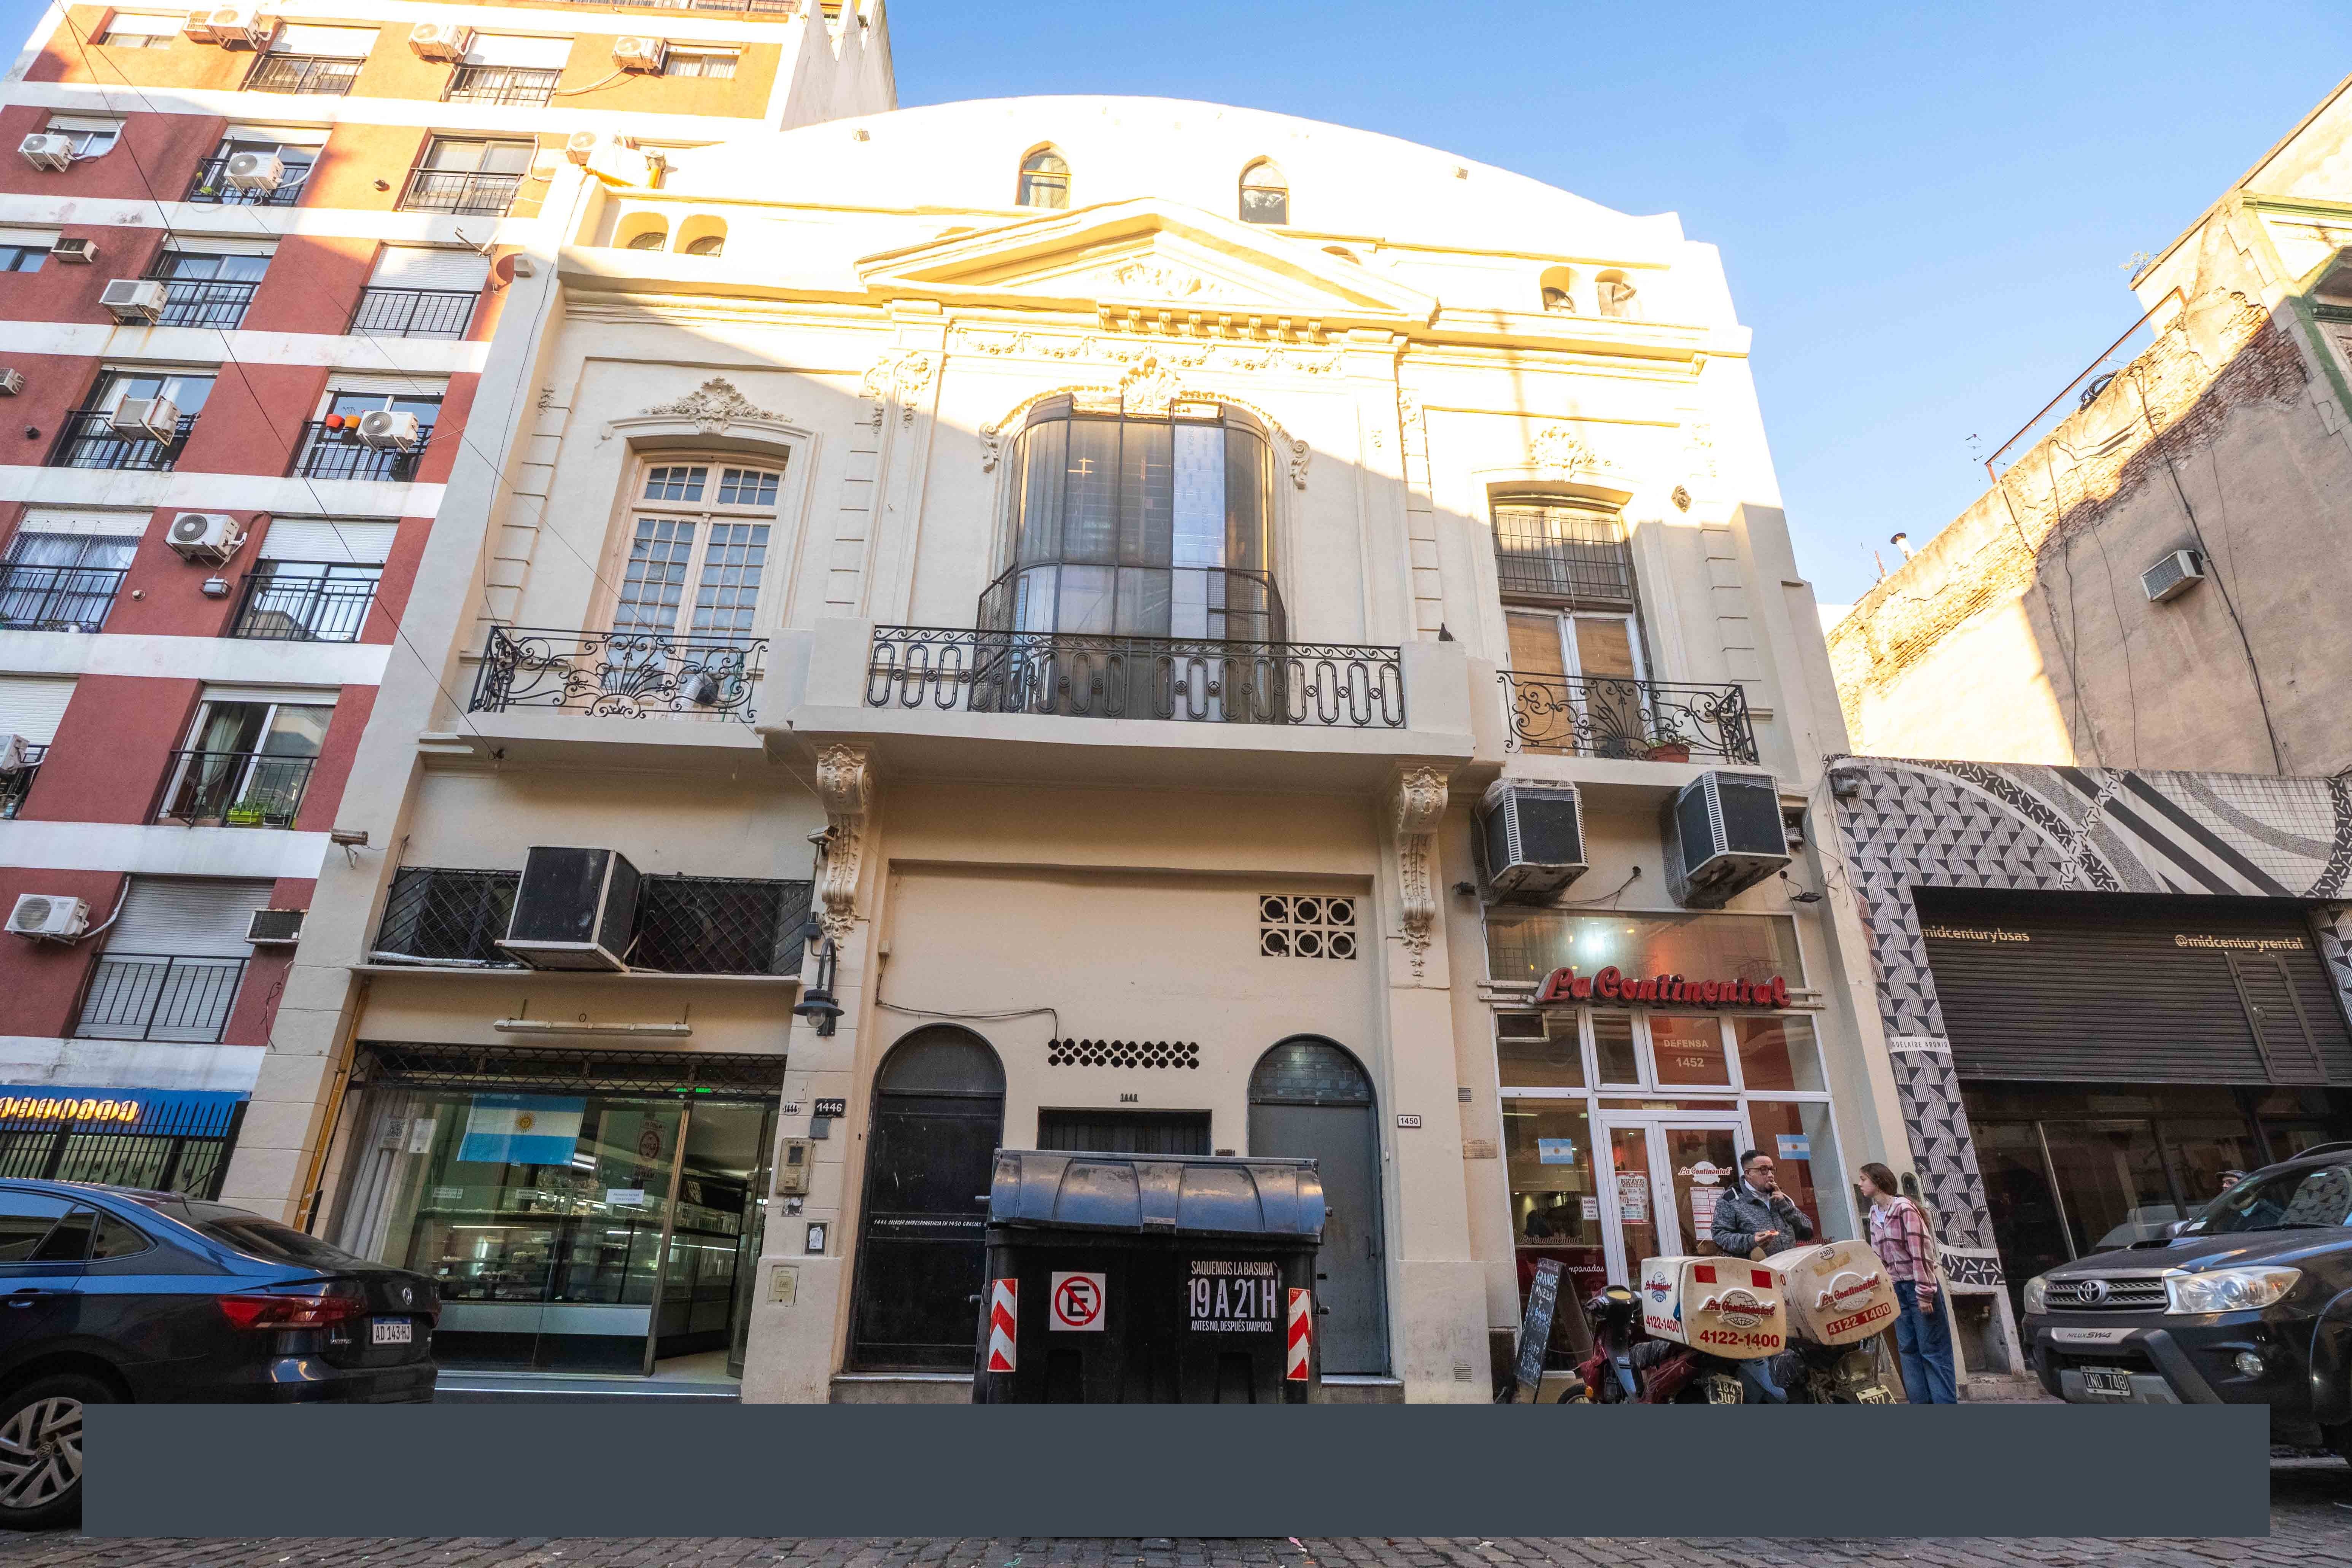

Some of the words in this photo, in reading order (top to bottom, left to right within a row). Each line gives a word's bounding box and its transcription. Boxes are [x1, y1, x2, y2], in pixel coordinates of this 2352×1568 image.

[2175, 935, 2304, 952] @midcenturyrental
[1538, 966, 1592, 1003] La
[1592, 966, 1791, 1008] Continental
[1663, 1039, 1708, 1048] DEFENSA
[1676, 1058, 1705, 1068] 1452
[784, 1104, 798, 1113] 1444
[816, 1102, 843, 1112] 1446
[1678, 1166, 1690, 1176] La
[1691, 1166, 1730, 1175] Continental
[1819, 1248, 1834, 1258] 2305
[1191, 1261, 1232, 1275] SAQUEMOS
[1234, 1261, 1243, 1275] LA
[1244, 1262, 1274, 1275] BASURA
[1536, 1269, 1558, 1289] GRANDE
[1188, 1278, 1210, 1318] 19
[1215, 1279, 1230, 1318] A
[1234, 1279, 1255, 1318] 21
[1262, 1280, 1276, 1318] H
[1821, 1294, 1834, 1307] La
[1834, 1275, 1881, 1300] Continental
[1704, 1299, 1721, 1310] La
[1722, 1300, 1775, 1316] Continental
[1191, 1320, 1209, 1331] ANTES
[1210, 1321, 1220, 1333] NO,
[1220, 1319, 1245, 1332] DESPUÉS
[1245, 1321, 1273, 1332] TAMPOCO.
[1646, 1314, 1679, 1333] 4122-1400
[1829, 1316, 1859, 1335] 4122
[1862, 1303, 1891, 1322] 1400
[375, 1326, 385, 1341] AD
[387, 1326, 399, 1341] 143
[402, 1326, 410, 1340] HJ
[1699, 1329, 1780, 1348] 4122-1400
[1716, 1382, 1736, 1395] 184
[2106, 1374, 2127, 1390] 748
